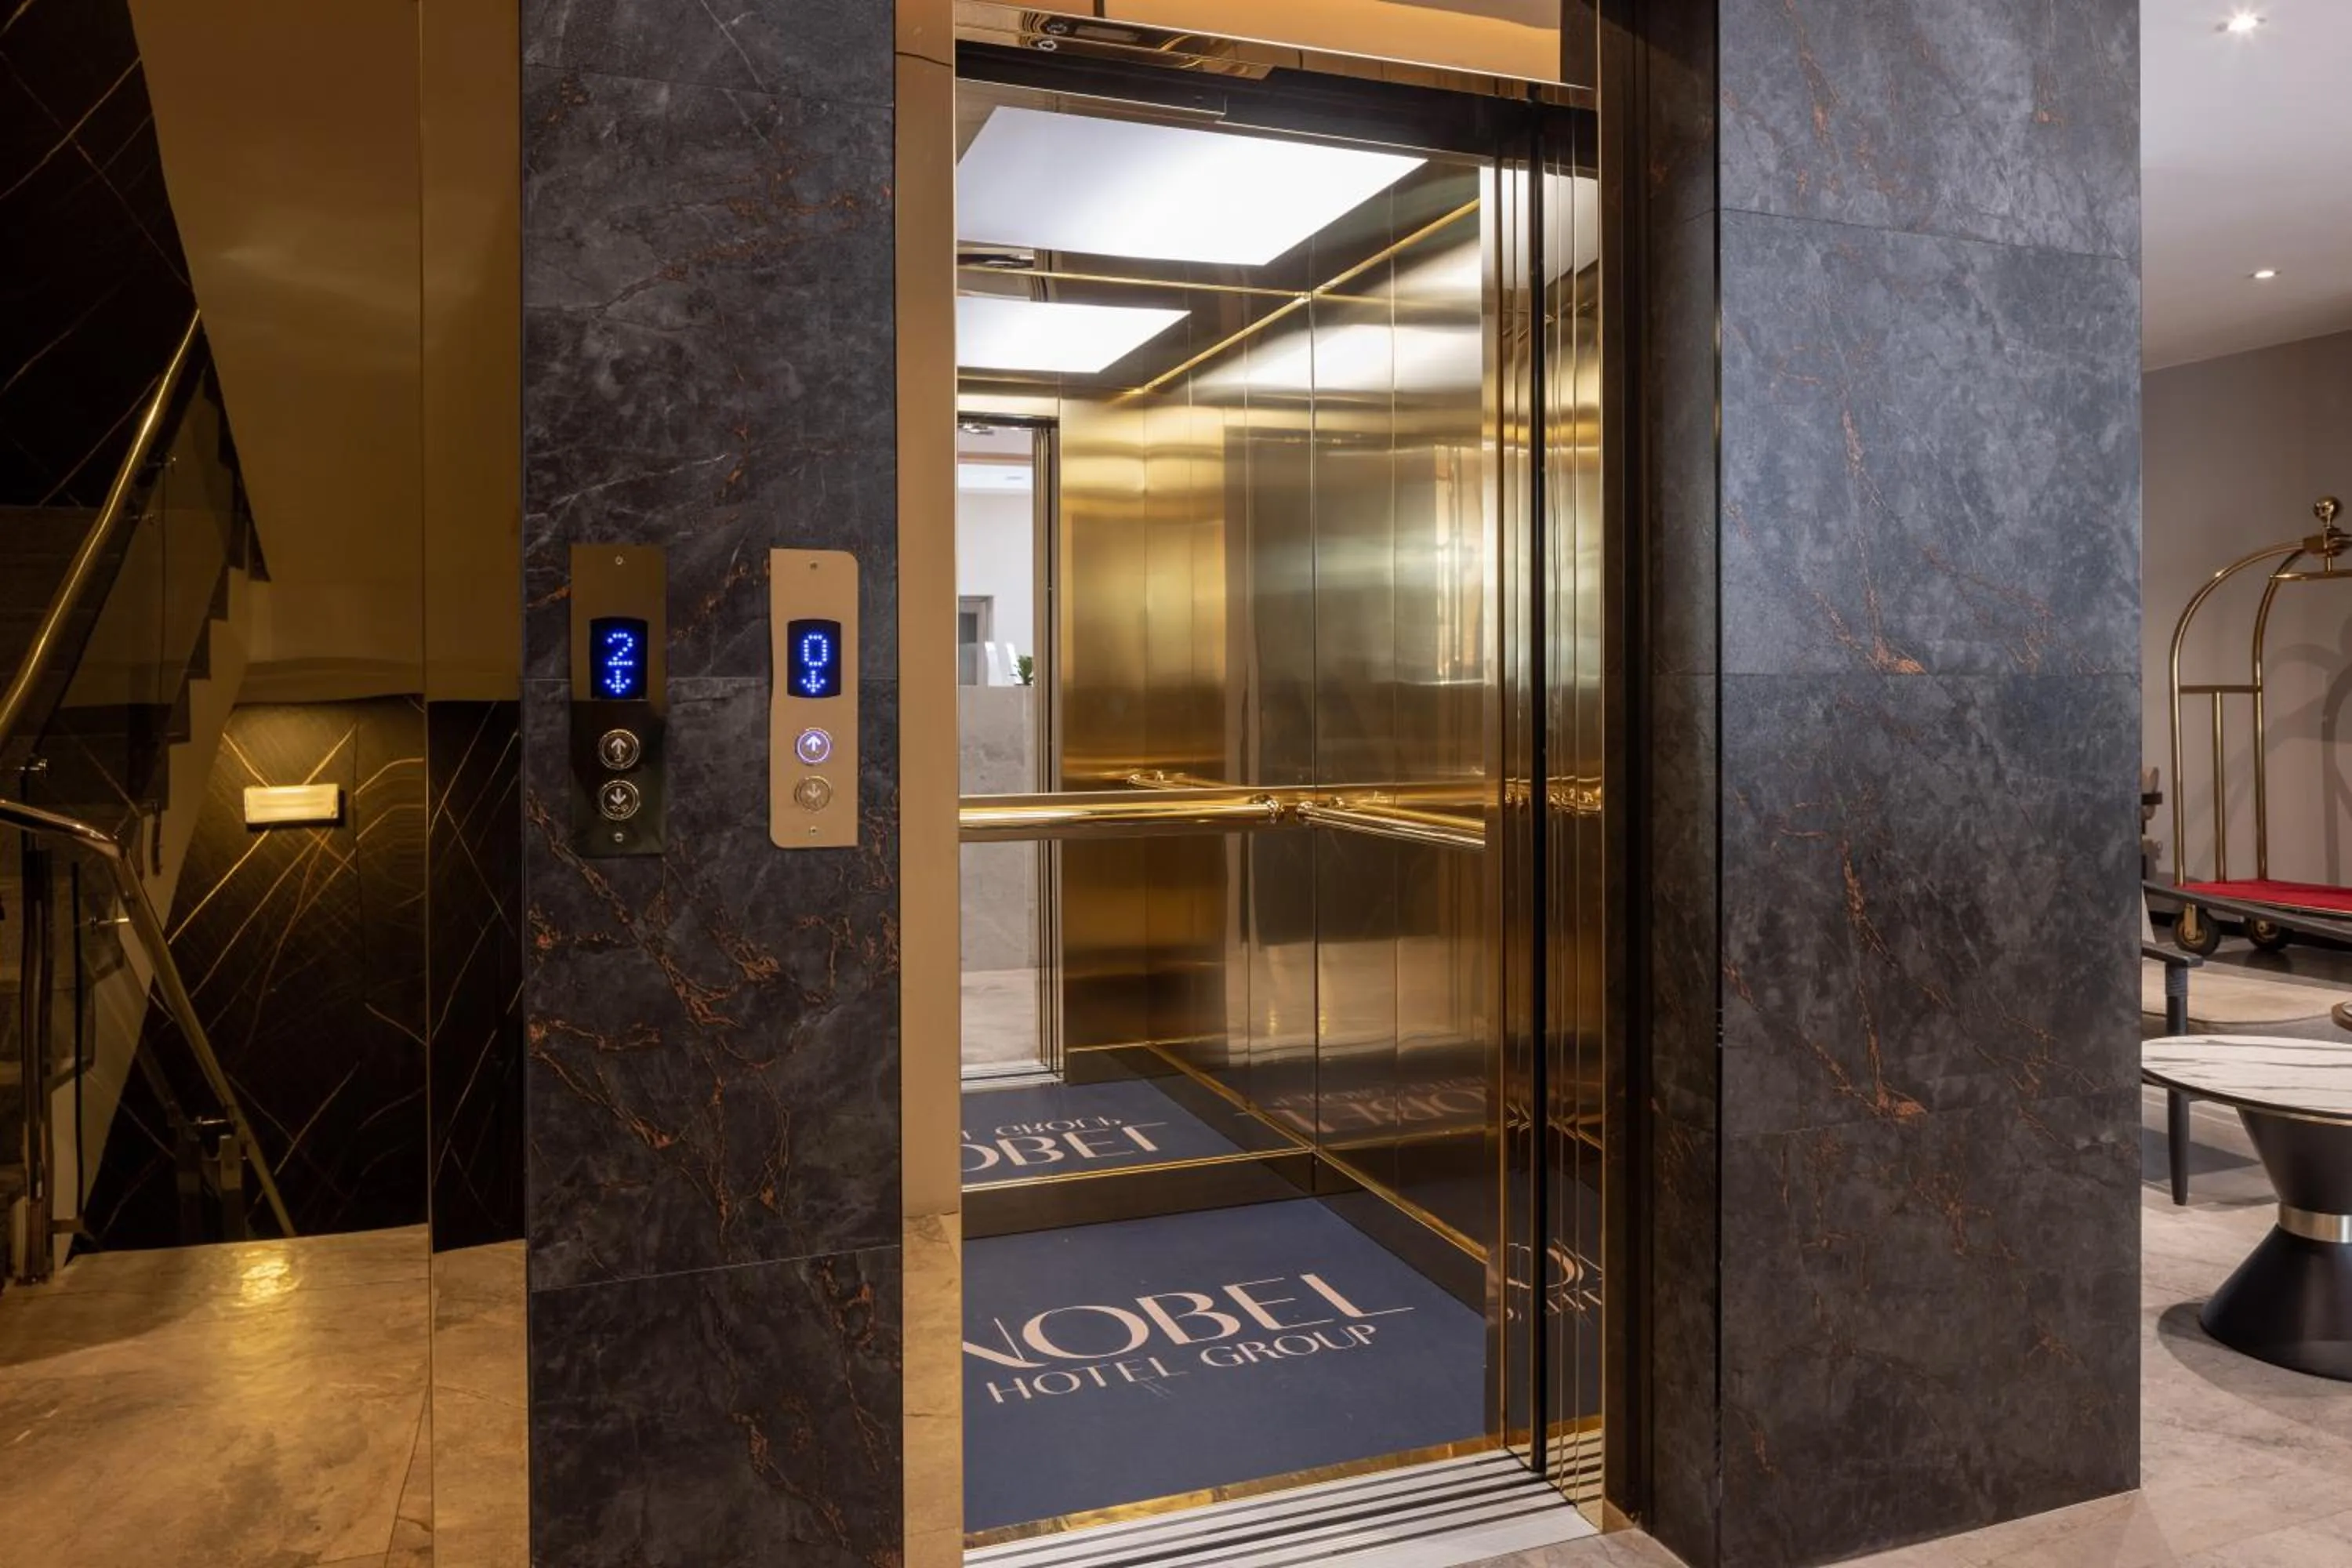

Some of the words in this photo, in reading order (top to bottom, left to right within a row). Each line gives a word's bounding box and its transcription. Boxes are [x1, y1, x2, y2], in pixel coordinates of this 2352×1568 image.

[607, 632, 633, 666] 2
[803, 634, 828, 666] 0
[986, 1357, 1189, 1403] HOTEL
[1200, 1324, 1377, 1367] GROUP
